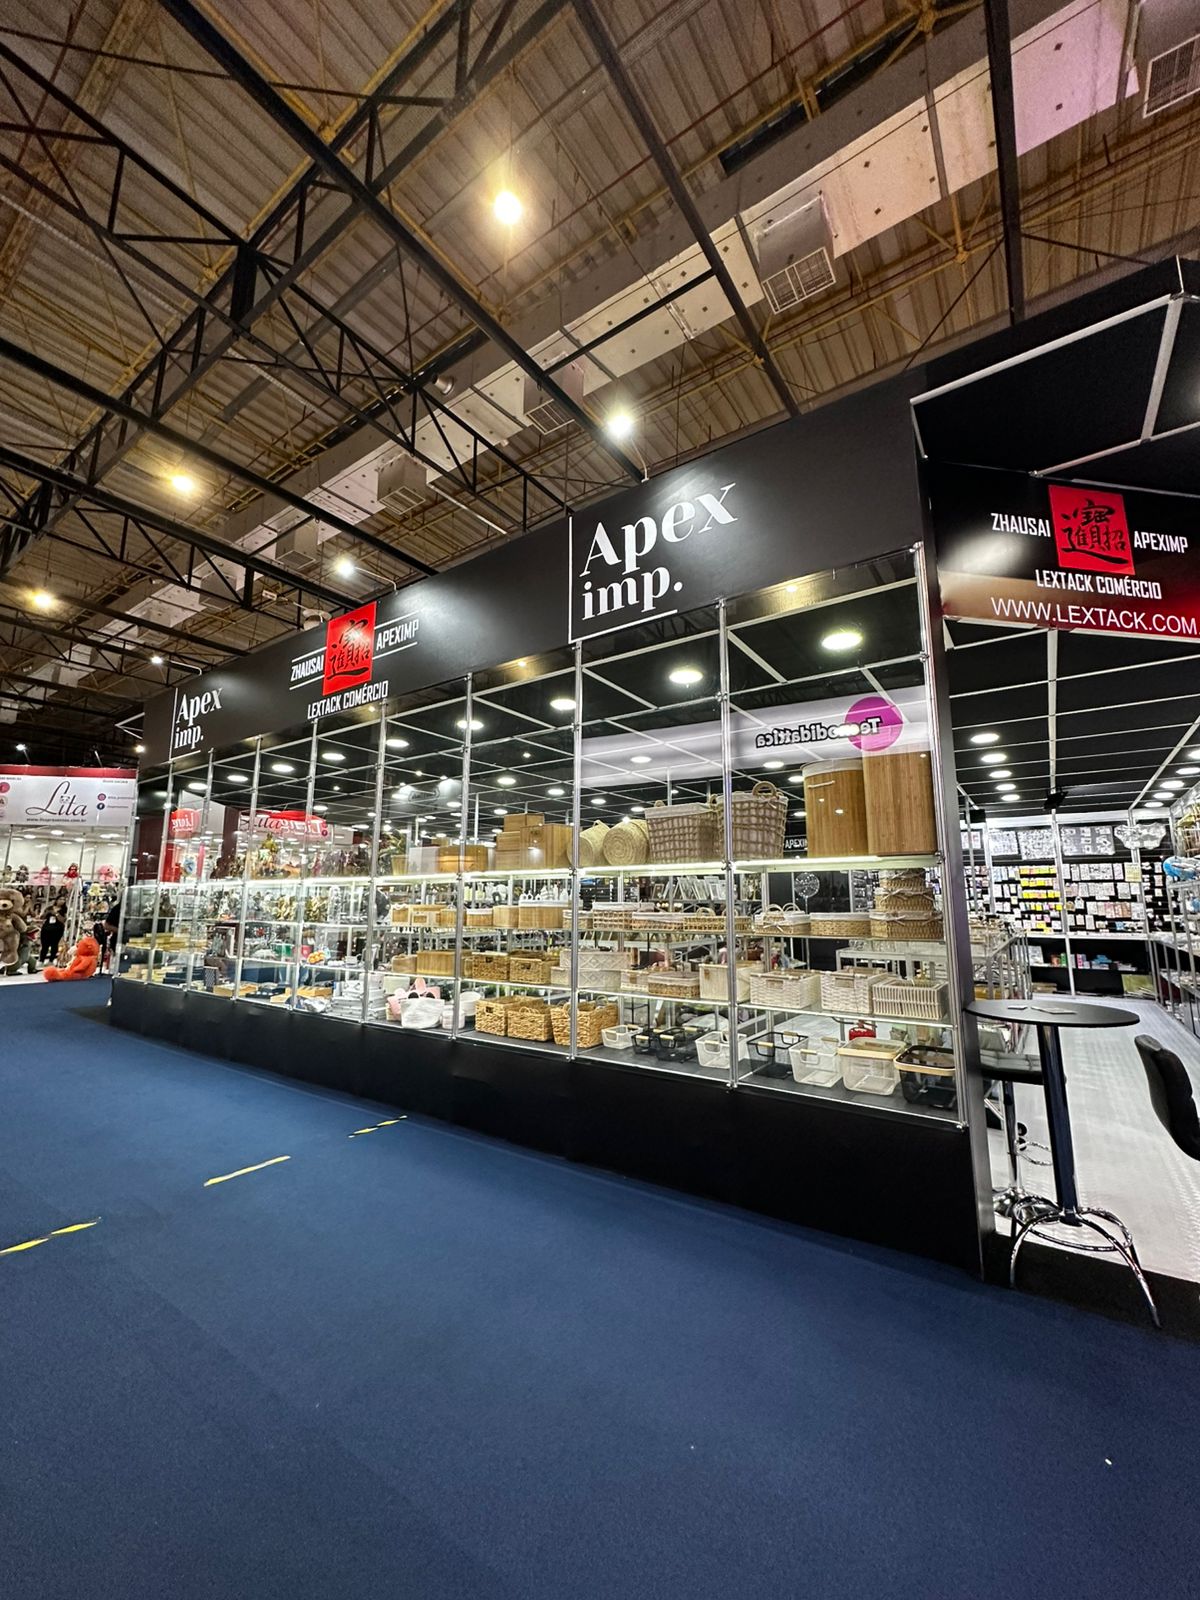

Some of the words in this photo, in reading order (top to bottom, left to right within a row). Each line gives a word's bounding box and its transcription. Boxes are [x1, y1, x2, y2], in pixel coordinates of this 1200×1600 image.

[579, 482, 738, 577] Apex
[990, 512, 1051, 537] ZHAUSAI
[1133, 530, 1189, 553] APEXIMP
[581, 566, 683, 620] imp.
[1034, 569, 1094, 593] LEXTACK
[1096, 575, 1163, 600] COMÉRCIO
[376, 618, 419, 651] APEXIMP
[290, 654, 325, 682] ZHAUSAI
[175, 687, 223, 727] Apex
[307, 694, 342, 720] LEXTACK
[343, 680, 389, 709] COMÉRCIO
[174, 725, 204, 750] imp.
[25, 780, 88, 816] Lita
